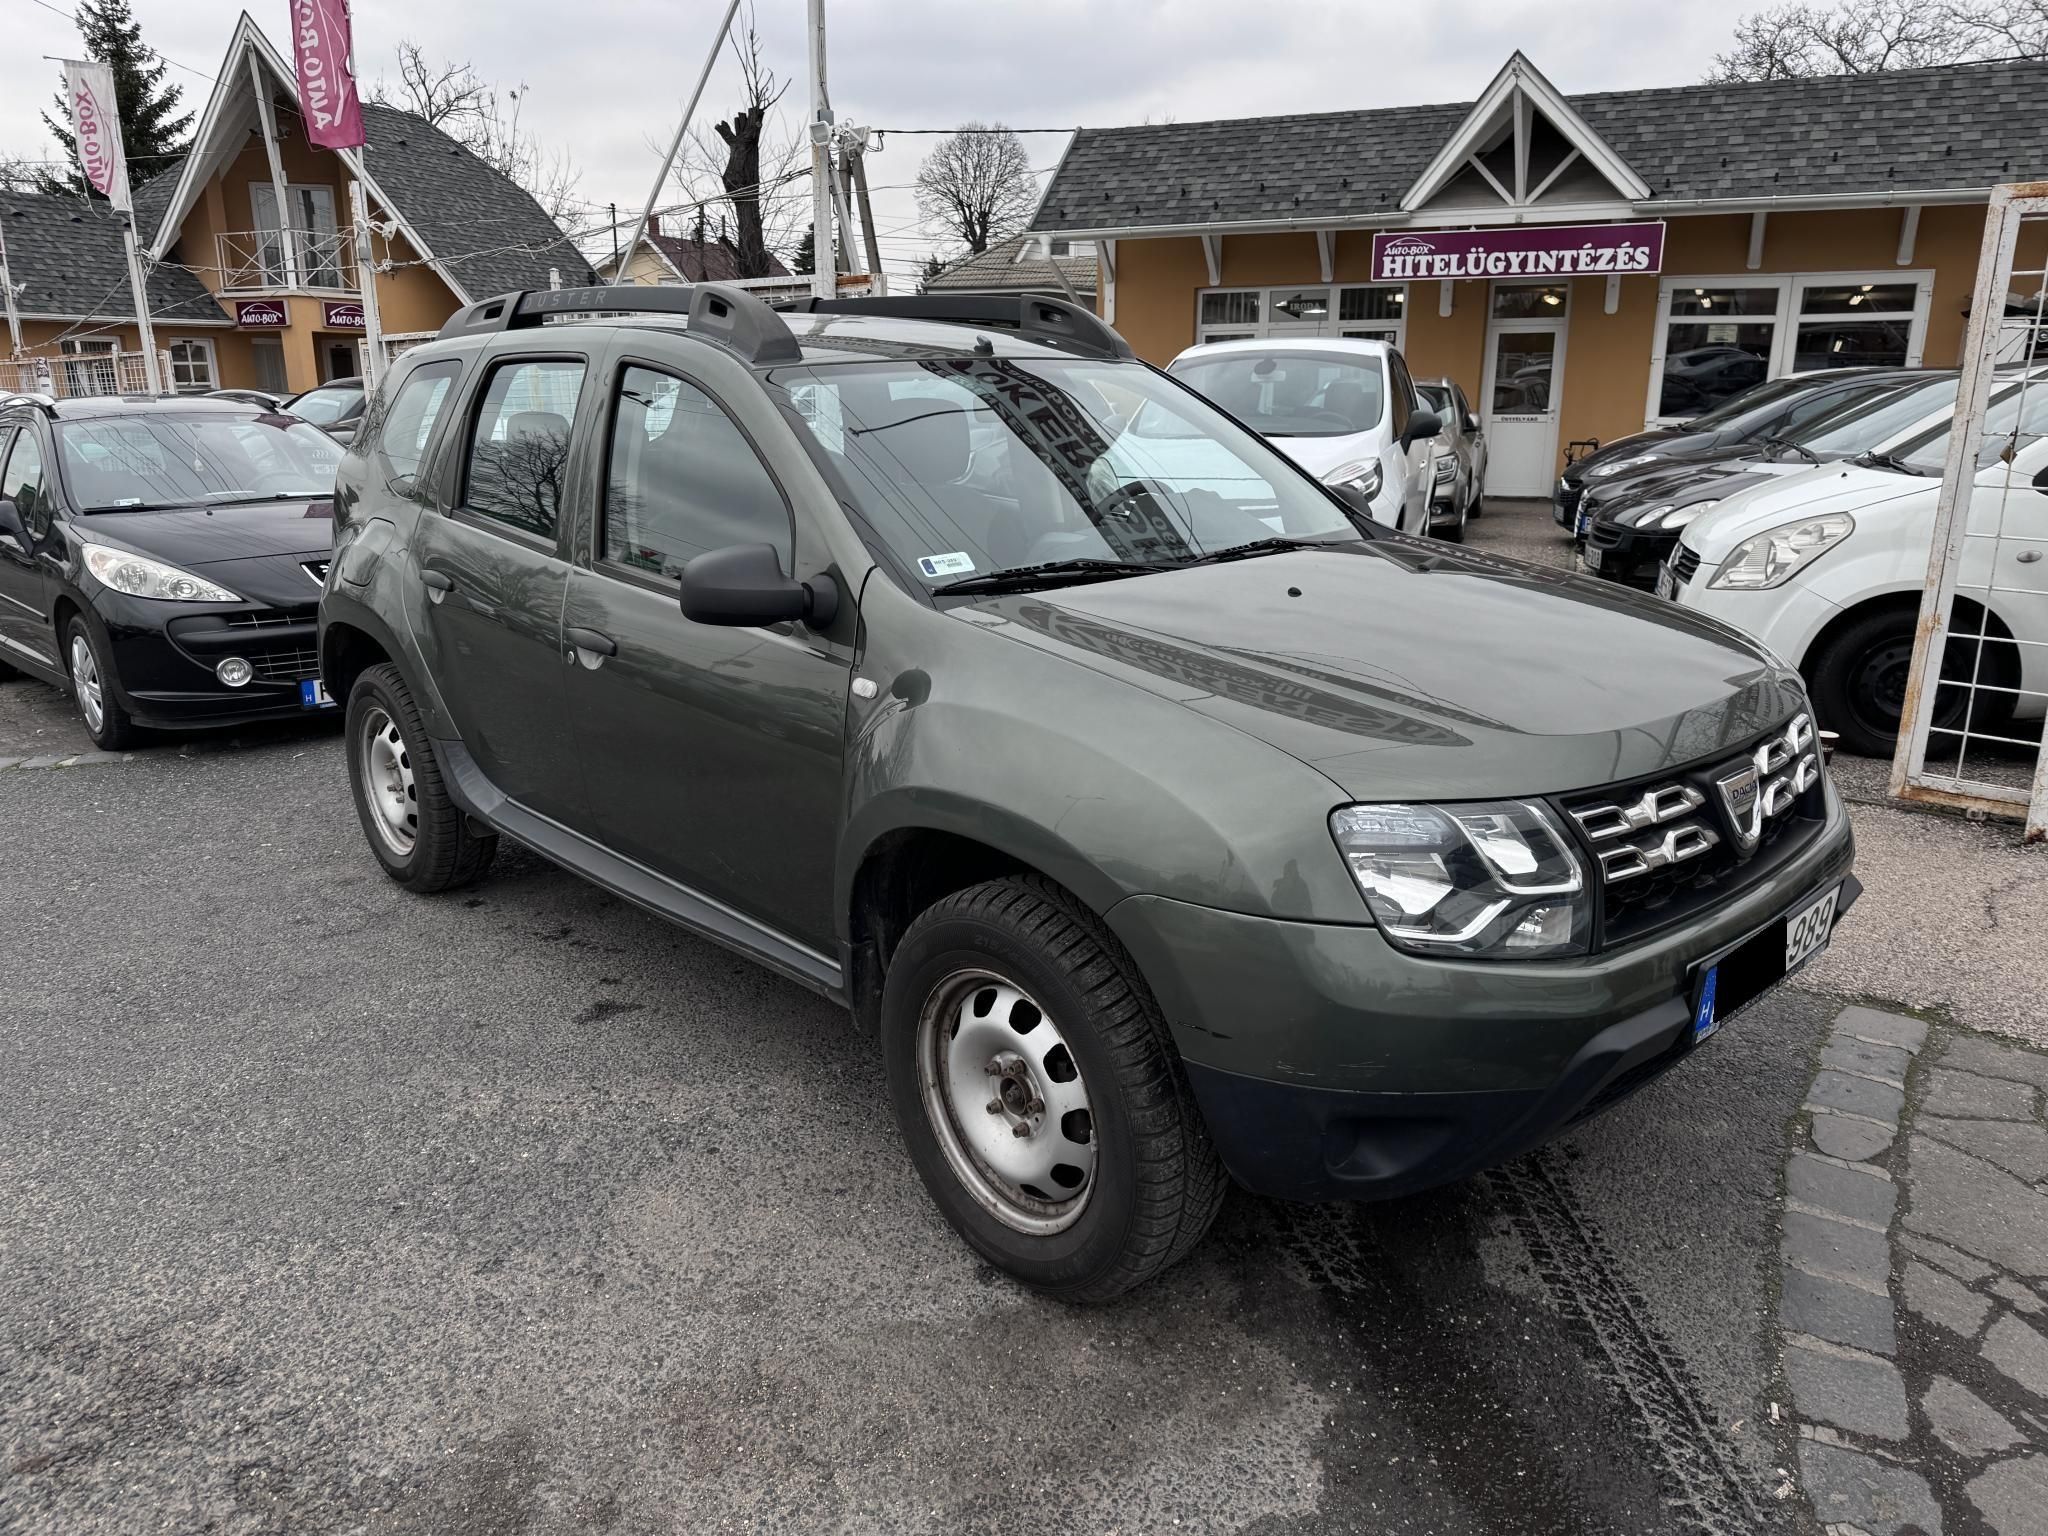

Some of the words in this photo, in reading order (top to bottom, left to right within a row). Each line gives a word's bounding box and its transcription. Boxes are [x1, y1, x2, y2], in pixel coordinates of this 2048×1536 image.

[1381, 241, 1650, 278] HITELÜGYINTÉZÉS
[1384, 246, 1430, 256] AUTO-BOX
[523, 290, 607, 311] DUSTER
[241, 313, 279, 324] AUTO-BOX
[1700, 1002, 1711, 1019] H
